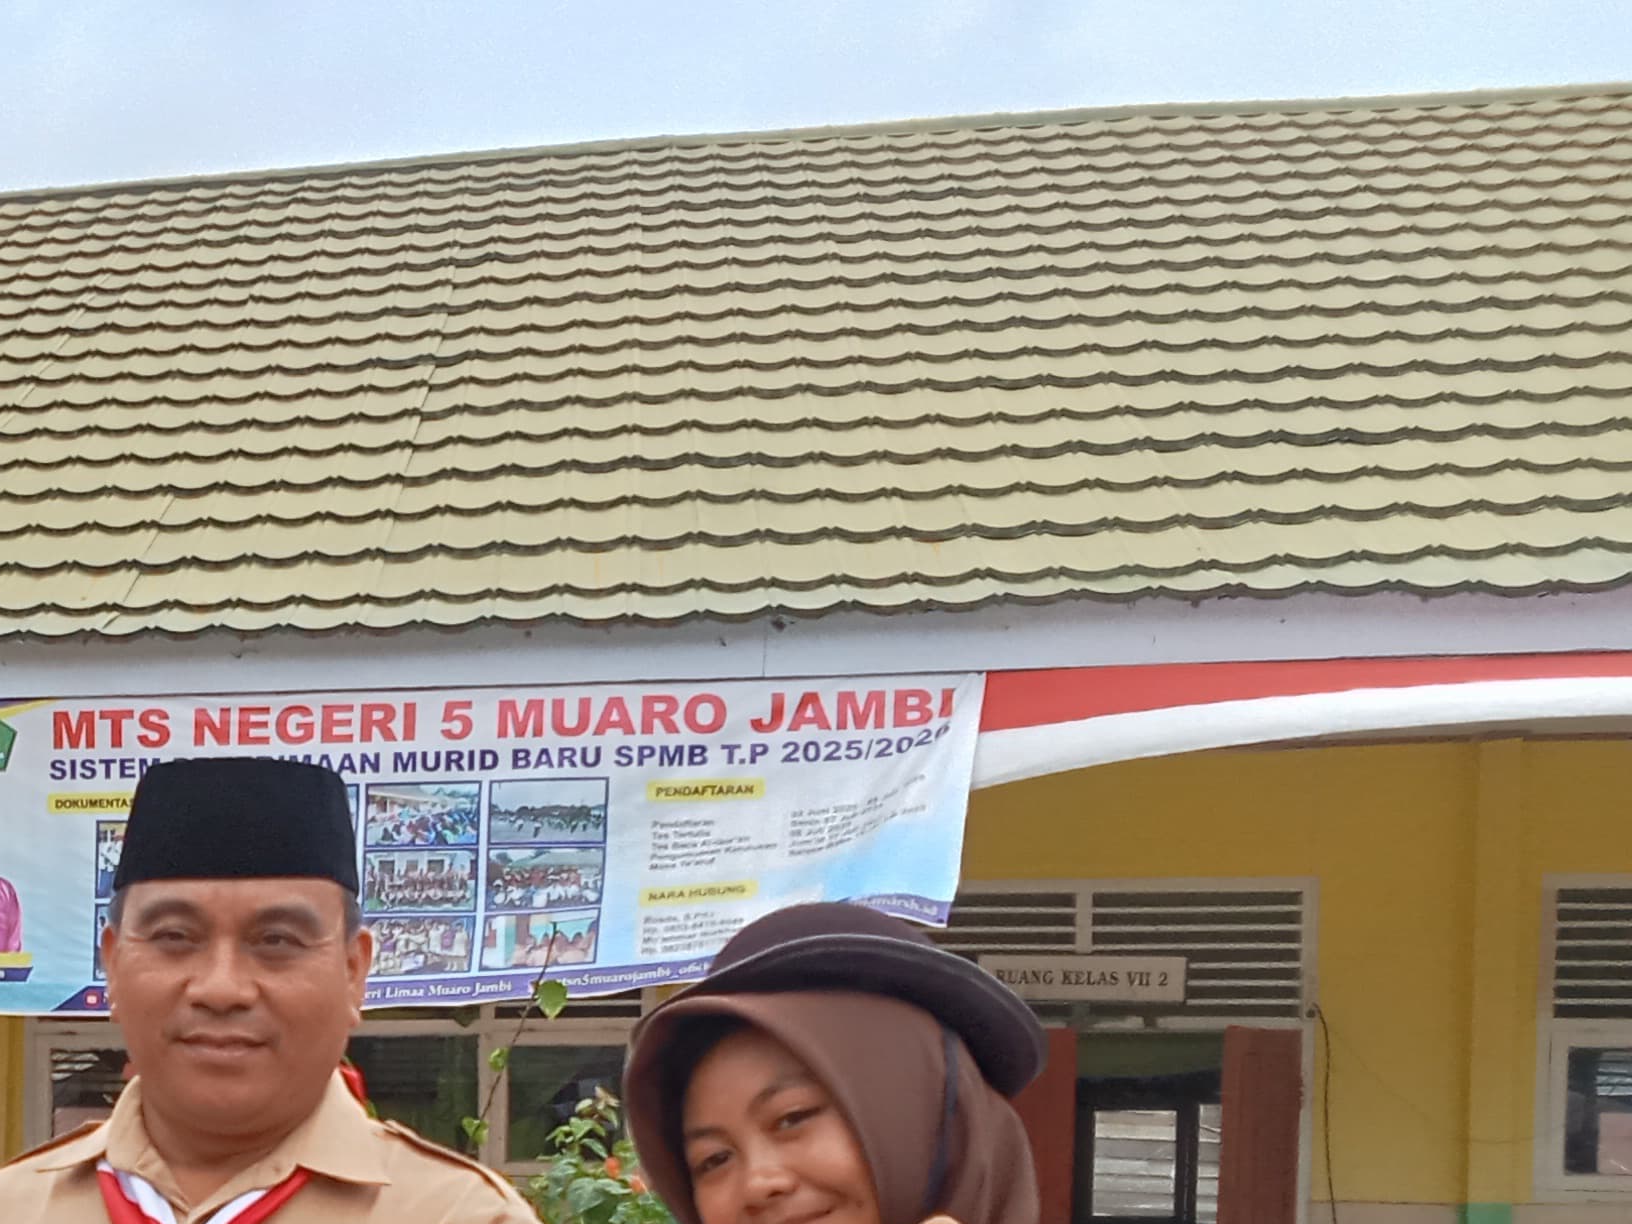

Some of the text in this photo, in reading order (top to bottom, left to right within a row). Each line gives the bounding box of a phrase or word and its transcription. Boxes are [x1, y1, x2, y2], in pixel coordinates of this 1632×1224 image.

[53, 688, 956, 749] MTS NEGERI 5 MUARO JAMBI
[393, 749, 500, 773] MURID
[512, 745, 602, 770] BARU
[613, 744, 709, 767] SPMB
[721, 743, 769, 765] T.P
[655, 784, 755, 797] PENDAFTARAN
[995, 969, 1168, 987] RUANG KELAS VII 2
[428, 984, 471, 996] Muaro
[472, 980, 512, 997] Jambi
